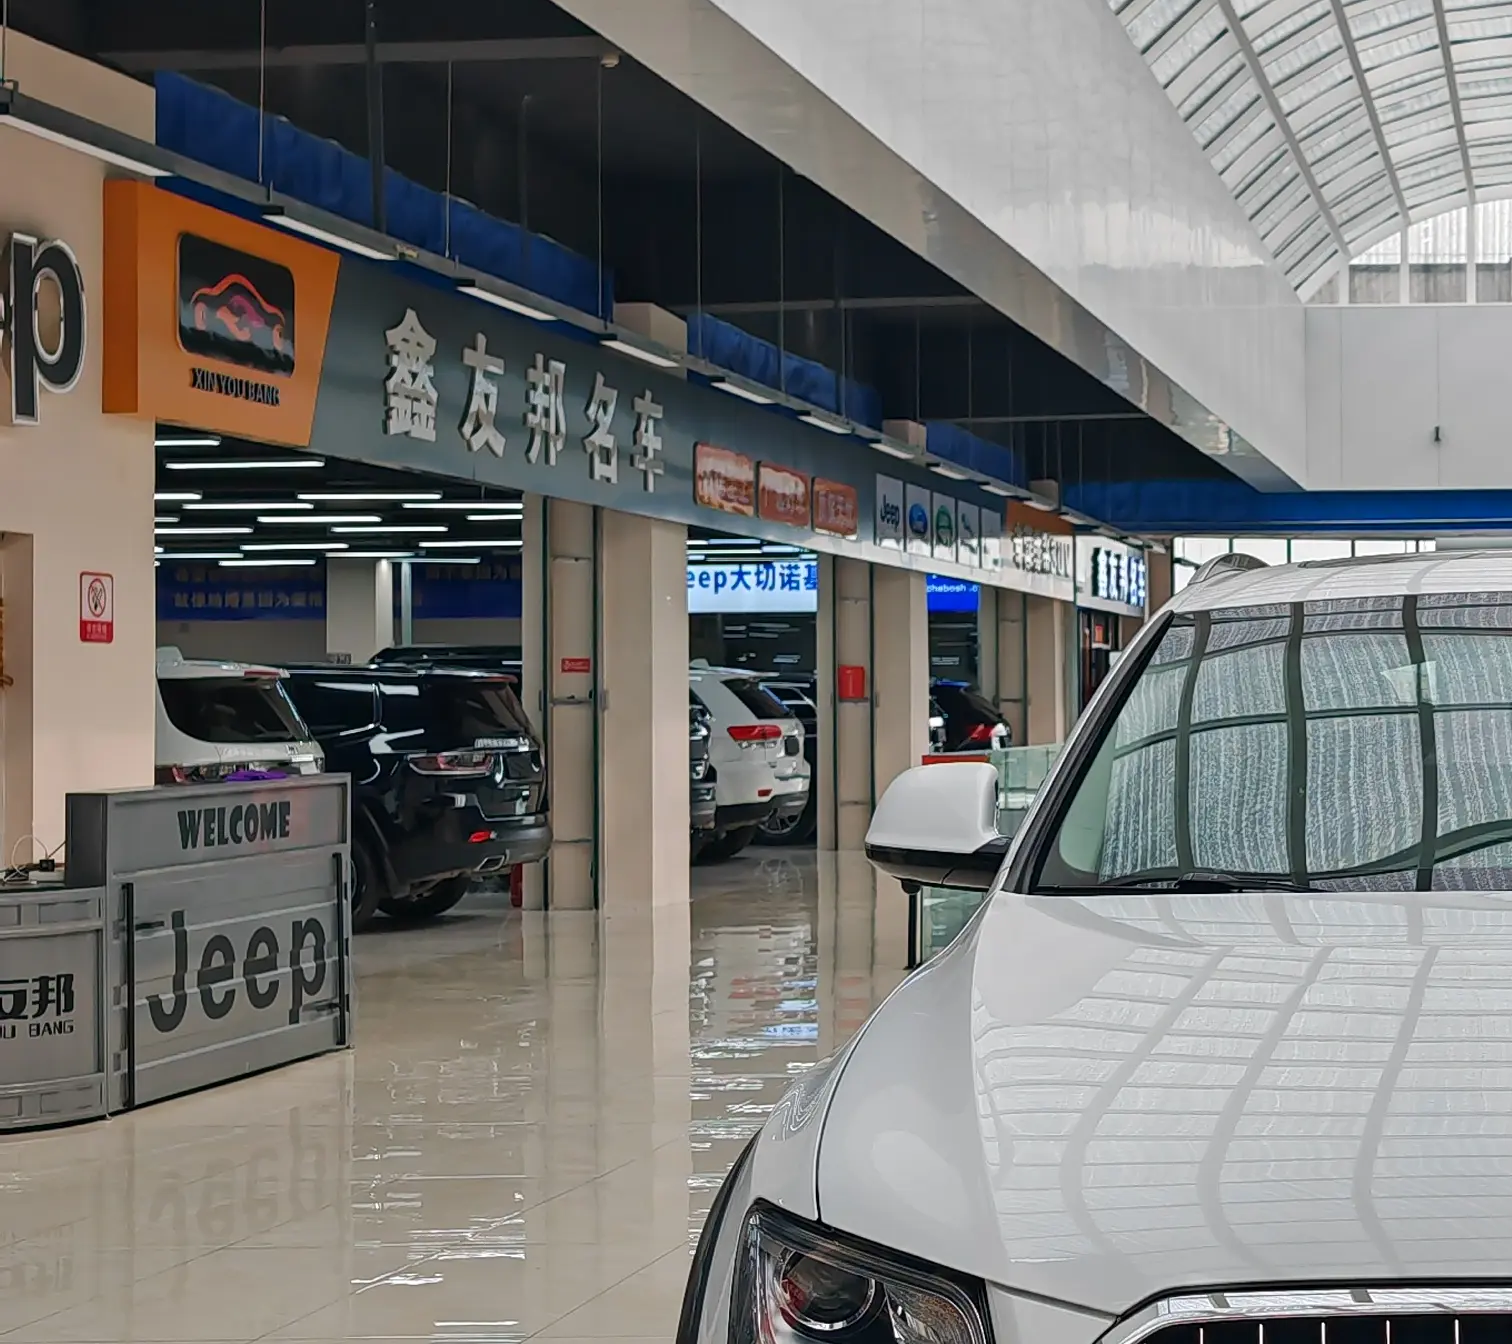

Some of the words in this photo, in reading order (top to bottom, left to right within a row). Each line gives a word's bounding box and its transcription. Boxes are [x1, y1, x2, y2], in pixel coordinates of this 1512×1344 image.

[0, 232, 88, 426] p
[383, 307, 665, 494] 鑫友邦名车
[177, 801, 291, 849] WELCOME
[0, 1024, 16, 1039] U
[29, 1020, 74, 1038] BANG
[148, 910, 327, 1033] Jeep
